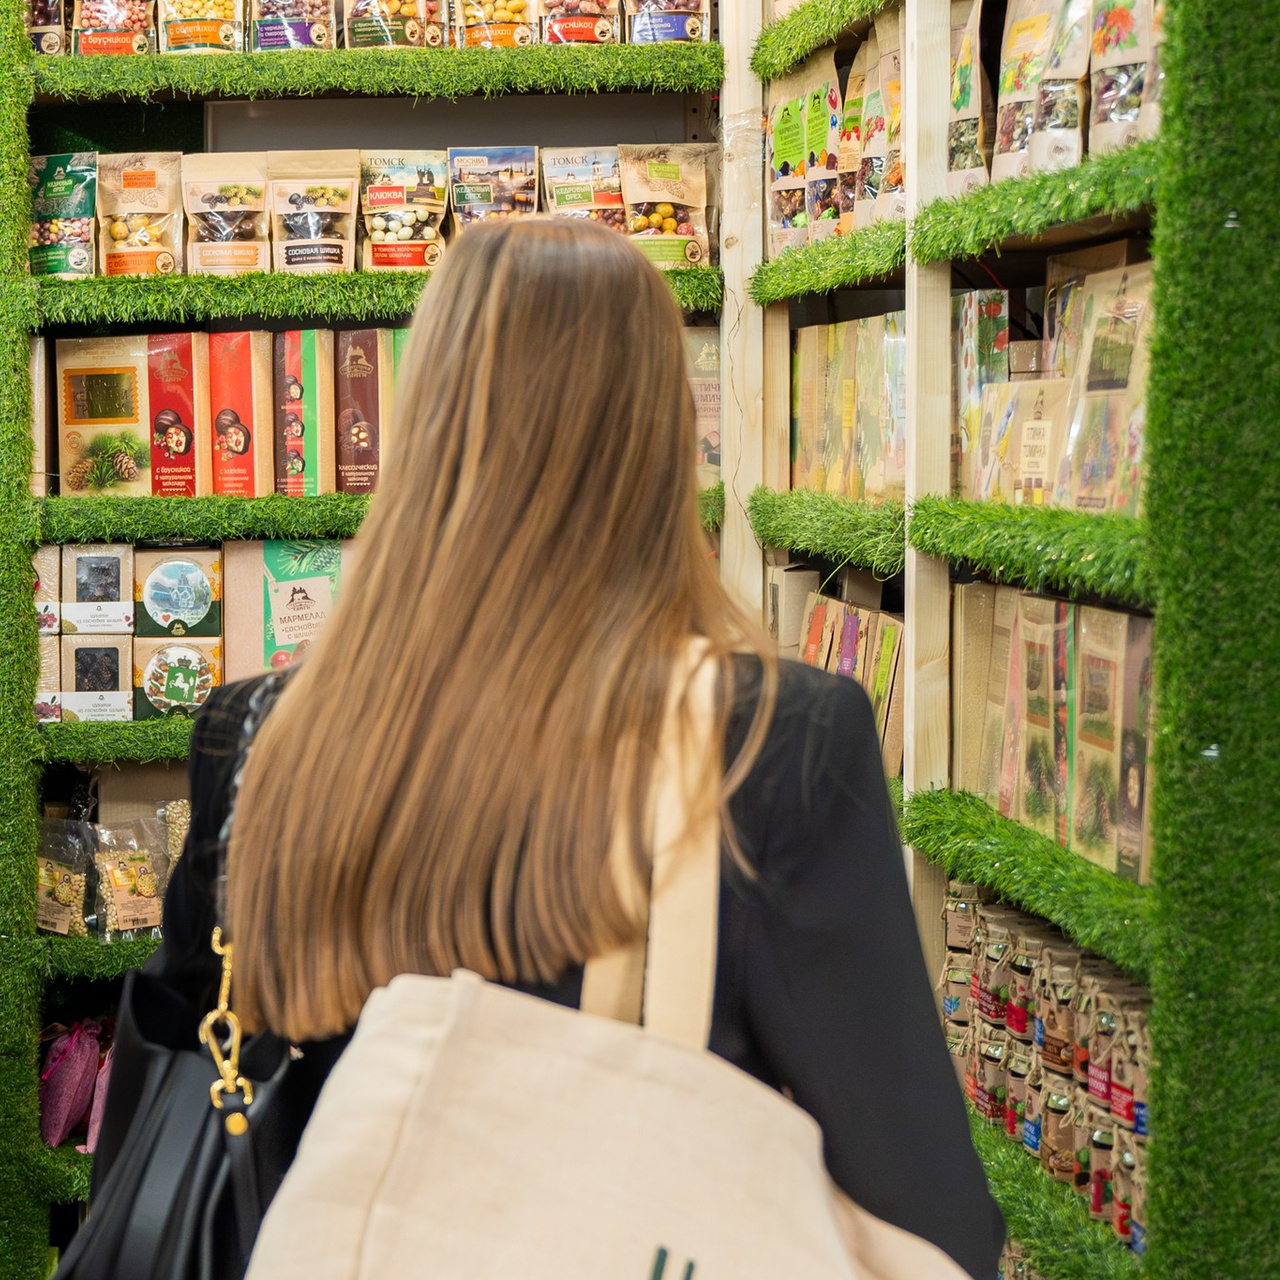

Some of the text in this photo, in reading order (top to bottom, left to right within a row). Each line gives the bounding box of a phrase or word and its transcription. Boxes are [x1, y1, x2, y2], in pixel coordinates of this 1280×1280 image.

[88, 36, 131, 46] брусникой
[368, 157, 405, 166] ТОМСК
[551, 155, 588, 166] ТОМСК
[369, 191, 404, 200] КЛЮКВА
[288, 247, 340, 256] СОСНОВАЯ ШИШКА
[279, 611, 326, 624] МАРМЕЛАД
